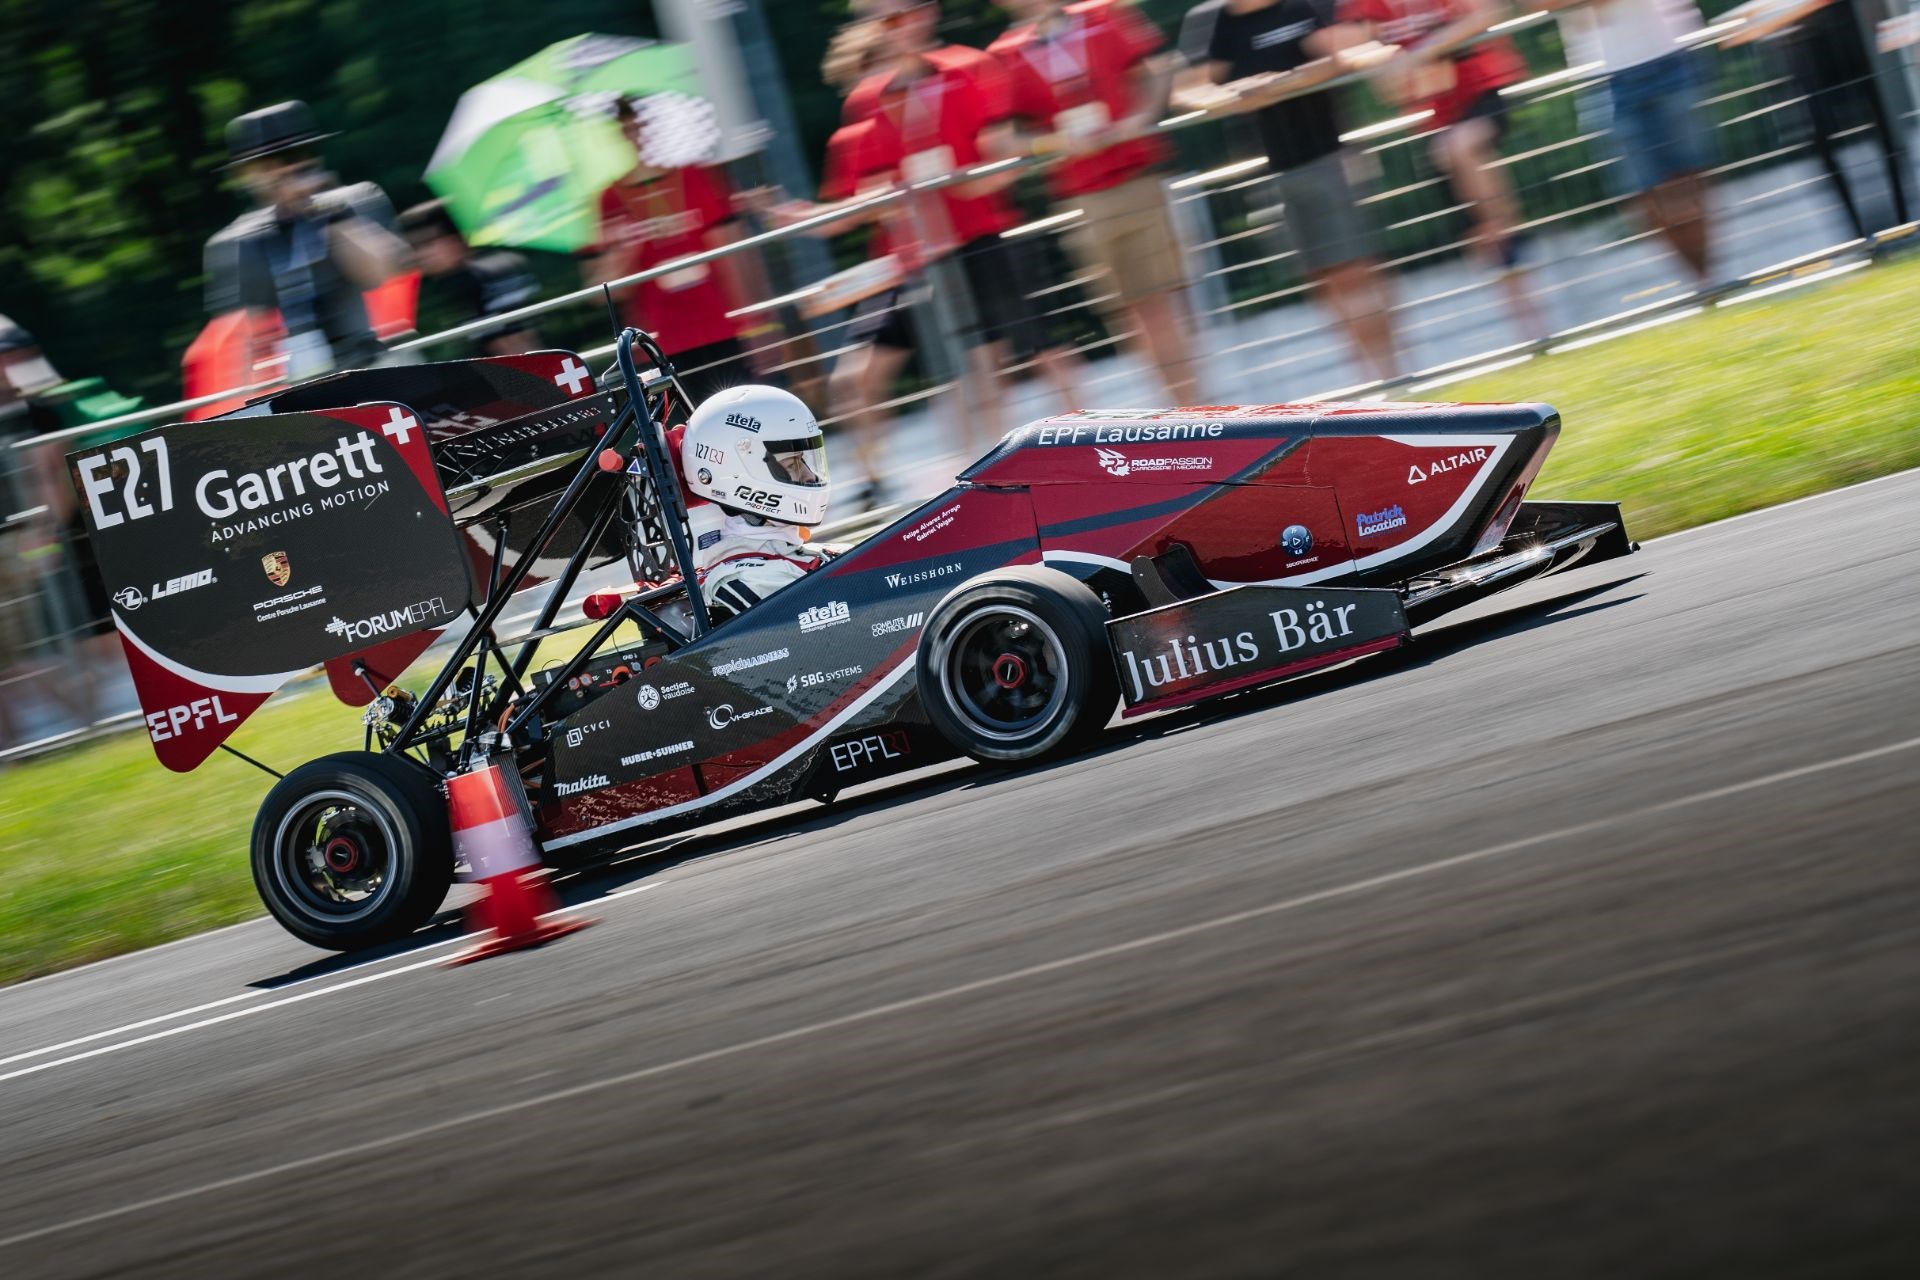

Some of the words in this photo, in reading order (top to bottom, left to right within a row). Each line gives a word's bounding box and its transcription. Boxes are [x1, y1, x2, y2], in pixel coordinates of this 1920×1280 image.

[726, 413, 762, 432] atela
[1038, 425, 1089, 445] EPF
[1095, 421, 1224, 443] Lausanne
[1131, 457, 1213, 467] ROADPASSION
[1430, 448, 1488, 476] ALTAIR
[77, 435, 174, 531] E27
[195, 431, 384, 519] Garrett
[211, 503, 314, 543] ADVANCING
[321, 480, 390, 511] MOTION
[745, 501, 782, 515] PROTECT
[1356, 504, 1405, 527] Patrick
[903, 529, 920, 541] Felipe
[920, 515, 941, 531] Alvarez
[942, 504, 961, 518] Arroyo
[916, 527, 937, 542] Gabriel
[1358, 516, 1407, 537] Location
[253, 585, 324, 611] PORSCHE
[256, 611, 277, 623] Centre
[276, 605, 300, 617] Porsche
[299, 597, 327, 611] Lausanne
[798, 600, 850, 626] atela
[871, 617, 905, 631] COMPUTER
[872, 624, 908, 637] CONTROLS
[1123, 632, 1260, 703] Julius
[1268, 600, 1356, 653] Bär
[660, 681, 690, 695] Section
[800, 671, 825, 688] SBG
[825, 664, 863, 682] SYSTEMS
[662, 686, 696, 700] vaudoise
[145, 695, 238, 743] EPFL
[729, 705, 774, 722] VI-GRADE
[582, 719, 612, 735] CVCI
[620, 740, 695, 767] HUBER+SUHNER
